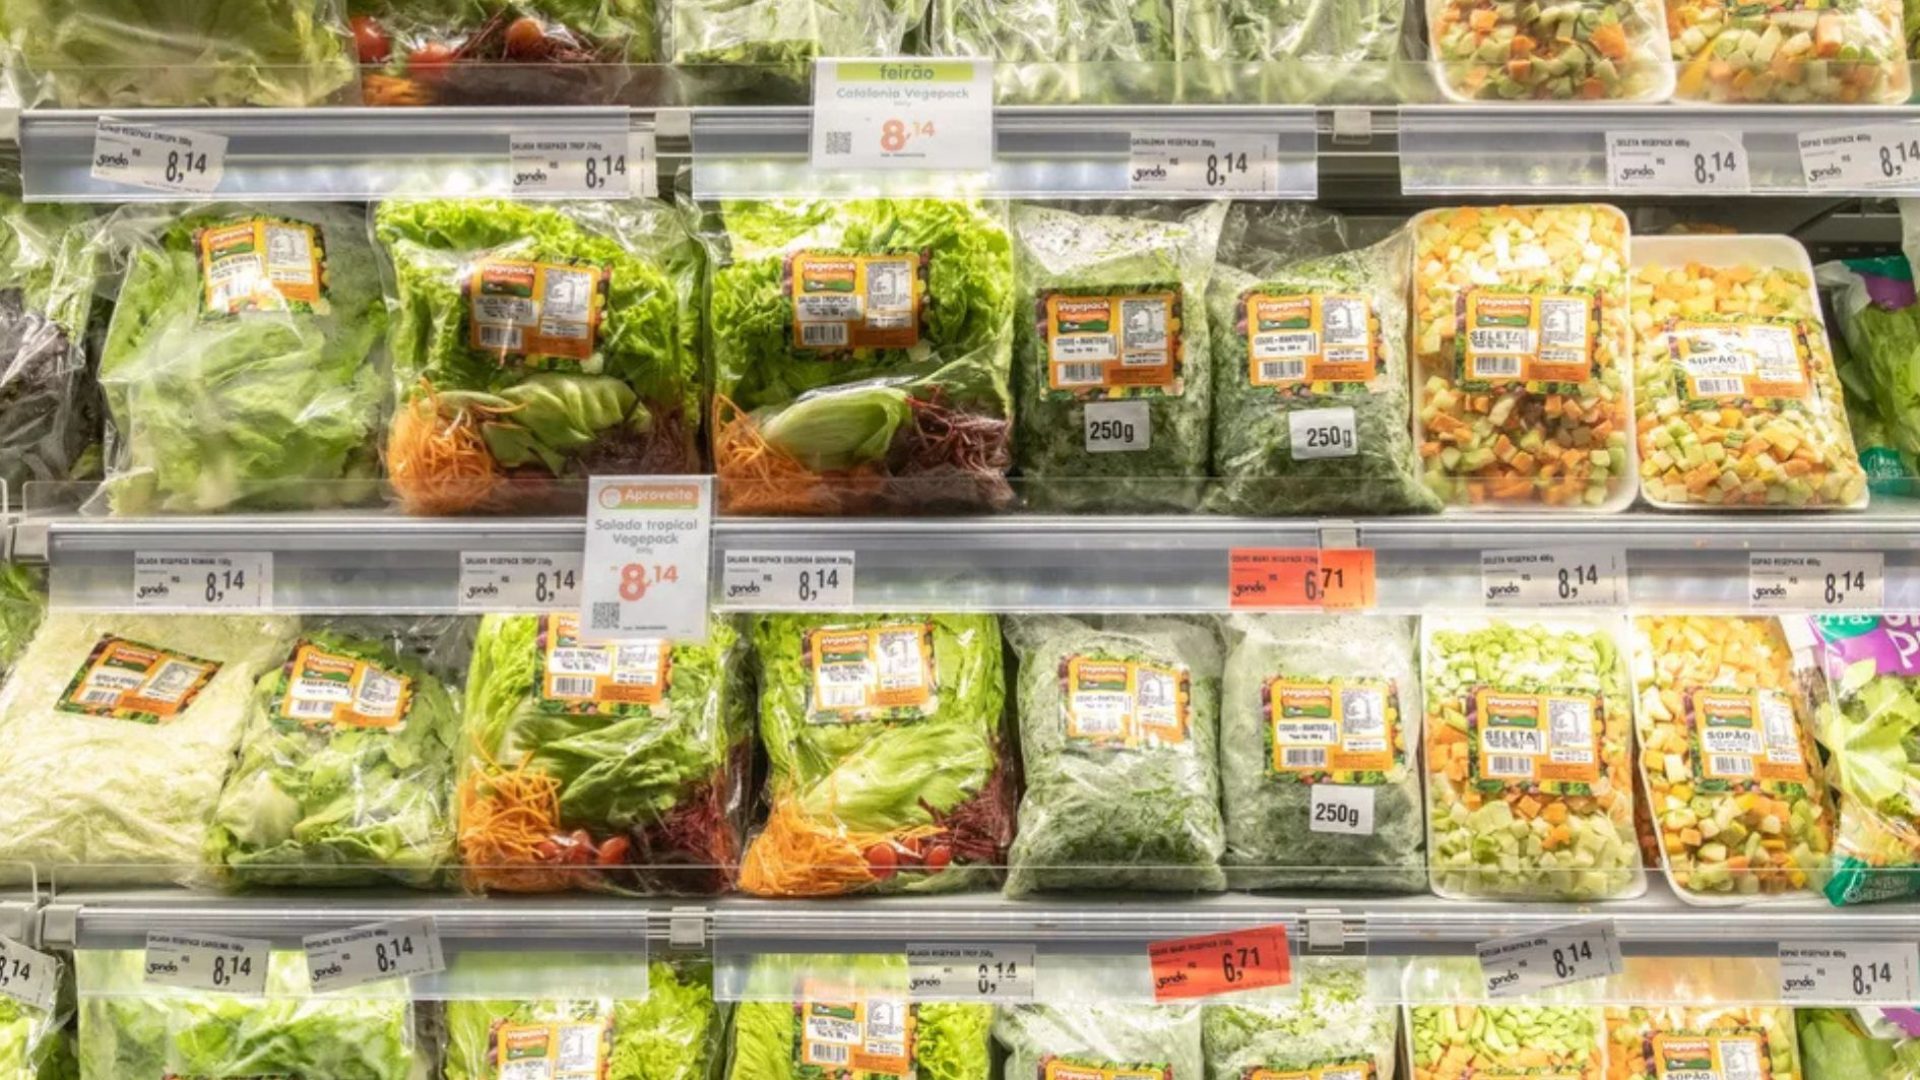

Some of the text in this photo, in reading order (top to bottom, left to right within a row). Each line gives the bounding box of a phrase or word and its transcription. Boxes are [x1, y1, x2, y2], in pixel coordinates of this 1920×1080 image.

[880, 64, 934, 80] feirão
[905, 87, 969, 101] Vegepack
[881, 119, 935, 152] 8,14
[166, 151, 206, 182] 8,14
[586, 155, 625, 188] 8,14
[1206, 152, 1248, 186] 8,14
[1694, 152, 1736, 184] 8,14
[1879, 140, 1920, 177] 8,14
[1090, 421, 1134, 443] 250g
[1307, 426, 1352, 448] 250g
[626, 489, 693, 503] Aproveite
[595, 518, 697, 533] Salada tropical
[612, 533, 679, 547] Vegepack
[205, 570, 245, 602] 8,14
[536, 570, 575, 602] 8,14
[619, 563, 679, 602] 8,14
[799, 569, 839, 601] 8,14
[1305, 568, 1343, 600] 6,71
[1558, 564, 1598, 599] 8,14
[1825, 571, 1865, 603] 8,14
[1485, 730, 1535, 740] SELETA
[1707, 730, 1751, 740] SOPÃO
[1315, 803, 1359, 827] 250g
[376, 936, 414, 972] 8,14
[1223, 947, 1260, 982] 6,71
[1553, 940, 1592, 979] 8,14
[213, 956, 251, 985] 8,14
[1853, 963, 1892, 995] 8,14
